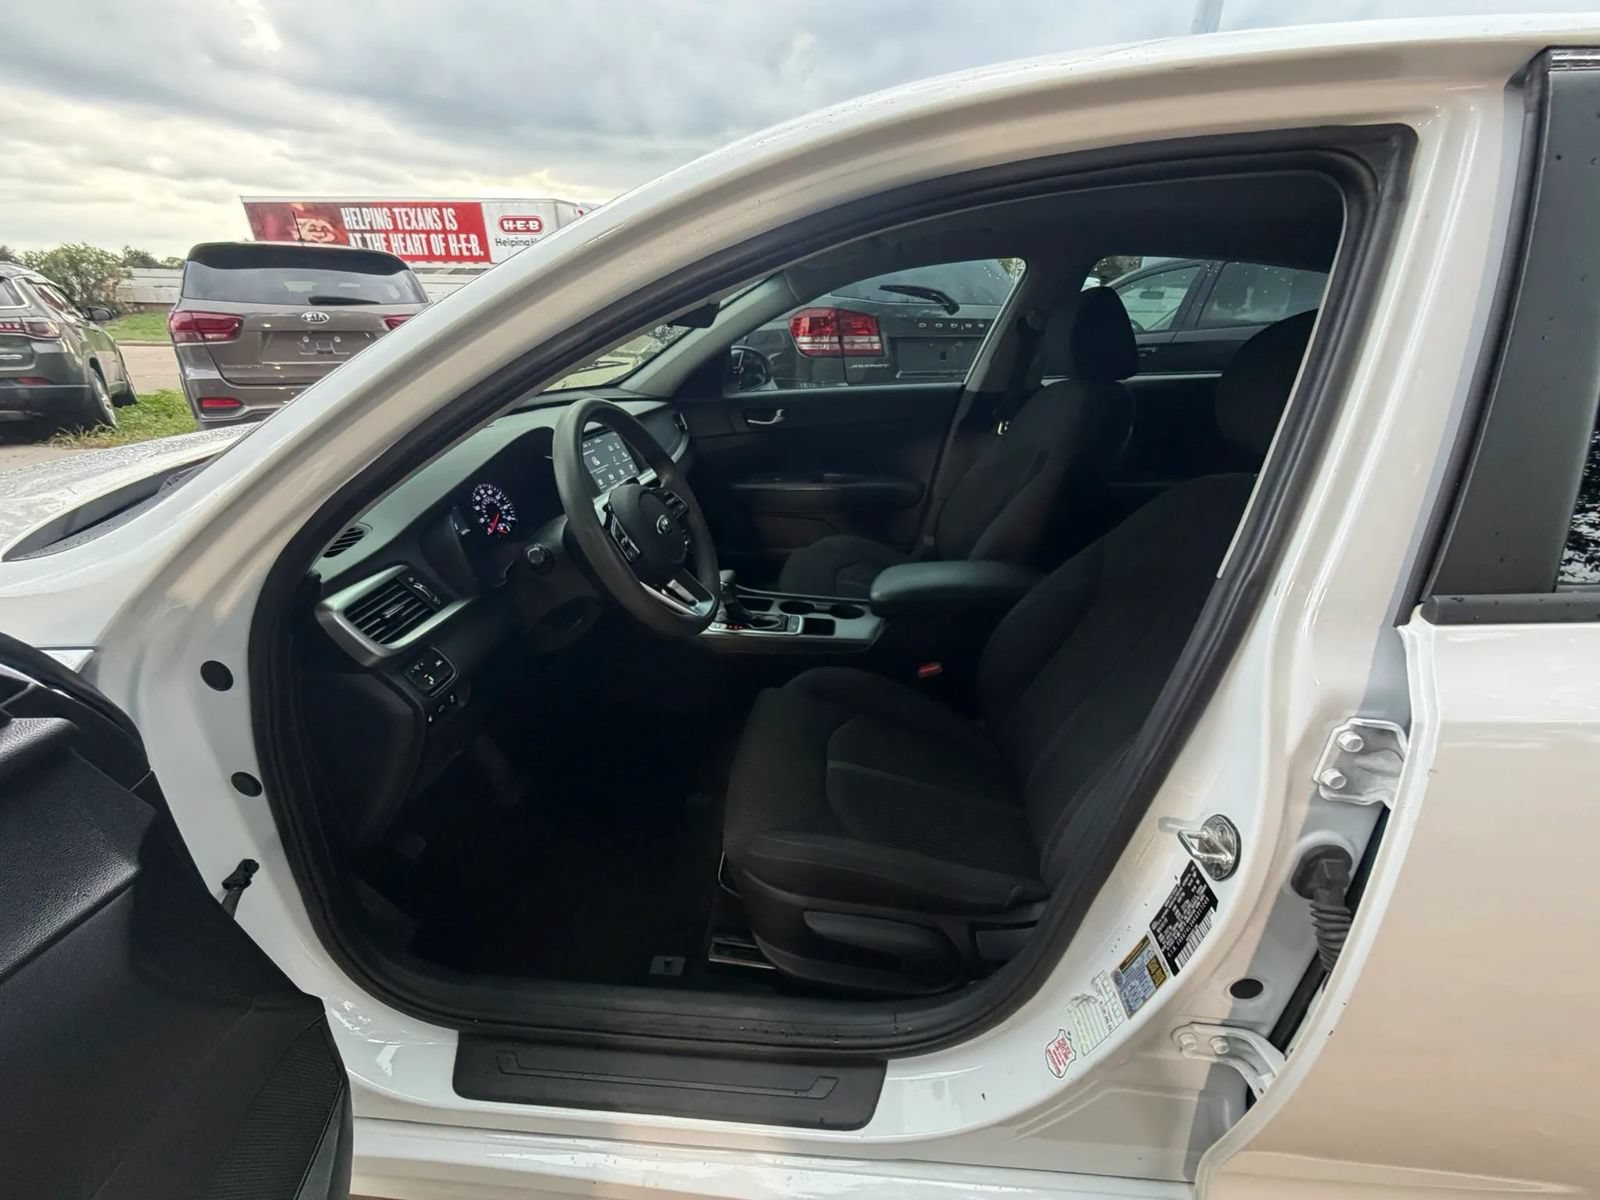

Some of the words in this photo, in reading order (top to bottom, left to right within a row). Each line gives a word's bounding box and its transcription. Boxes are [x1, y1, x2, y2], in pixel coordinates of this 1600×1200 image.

[340, 207, 394, 231] HELPING
[392, 207, 443, 231] TEXANS
[442, 207, 459, 231] IS
[363, 232, 388, 253] THE
[388, 233, 428, 256] HEART
[429, 234, 447, 256] OF
